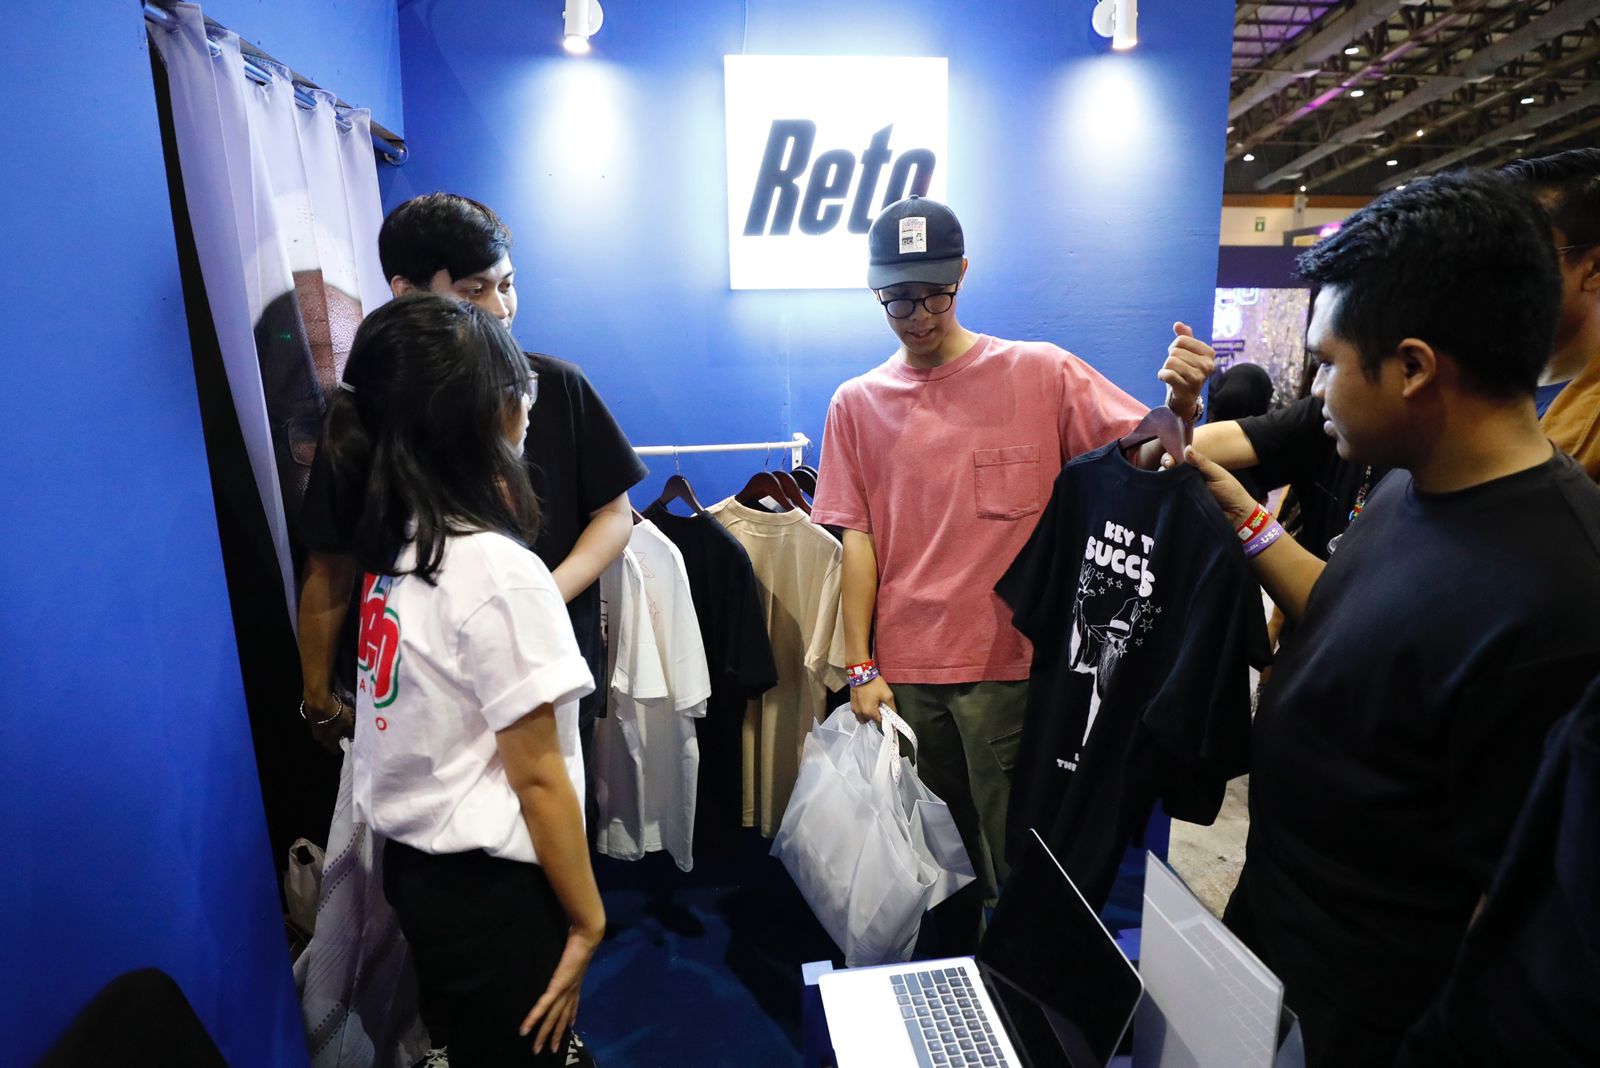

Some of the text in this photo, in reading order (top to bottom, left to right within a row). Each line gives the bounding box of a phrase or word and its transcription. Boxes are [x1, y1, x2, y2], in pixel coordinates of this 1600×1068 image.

[743, 118, 937, 237] Reto
[1104, 520, 1155, 555] KEY T
